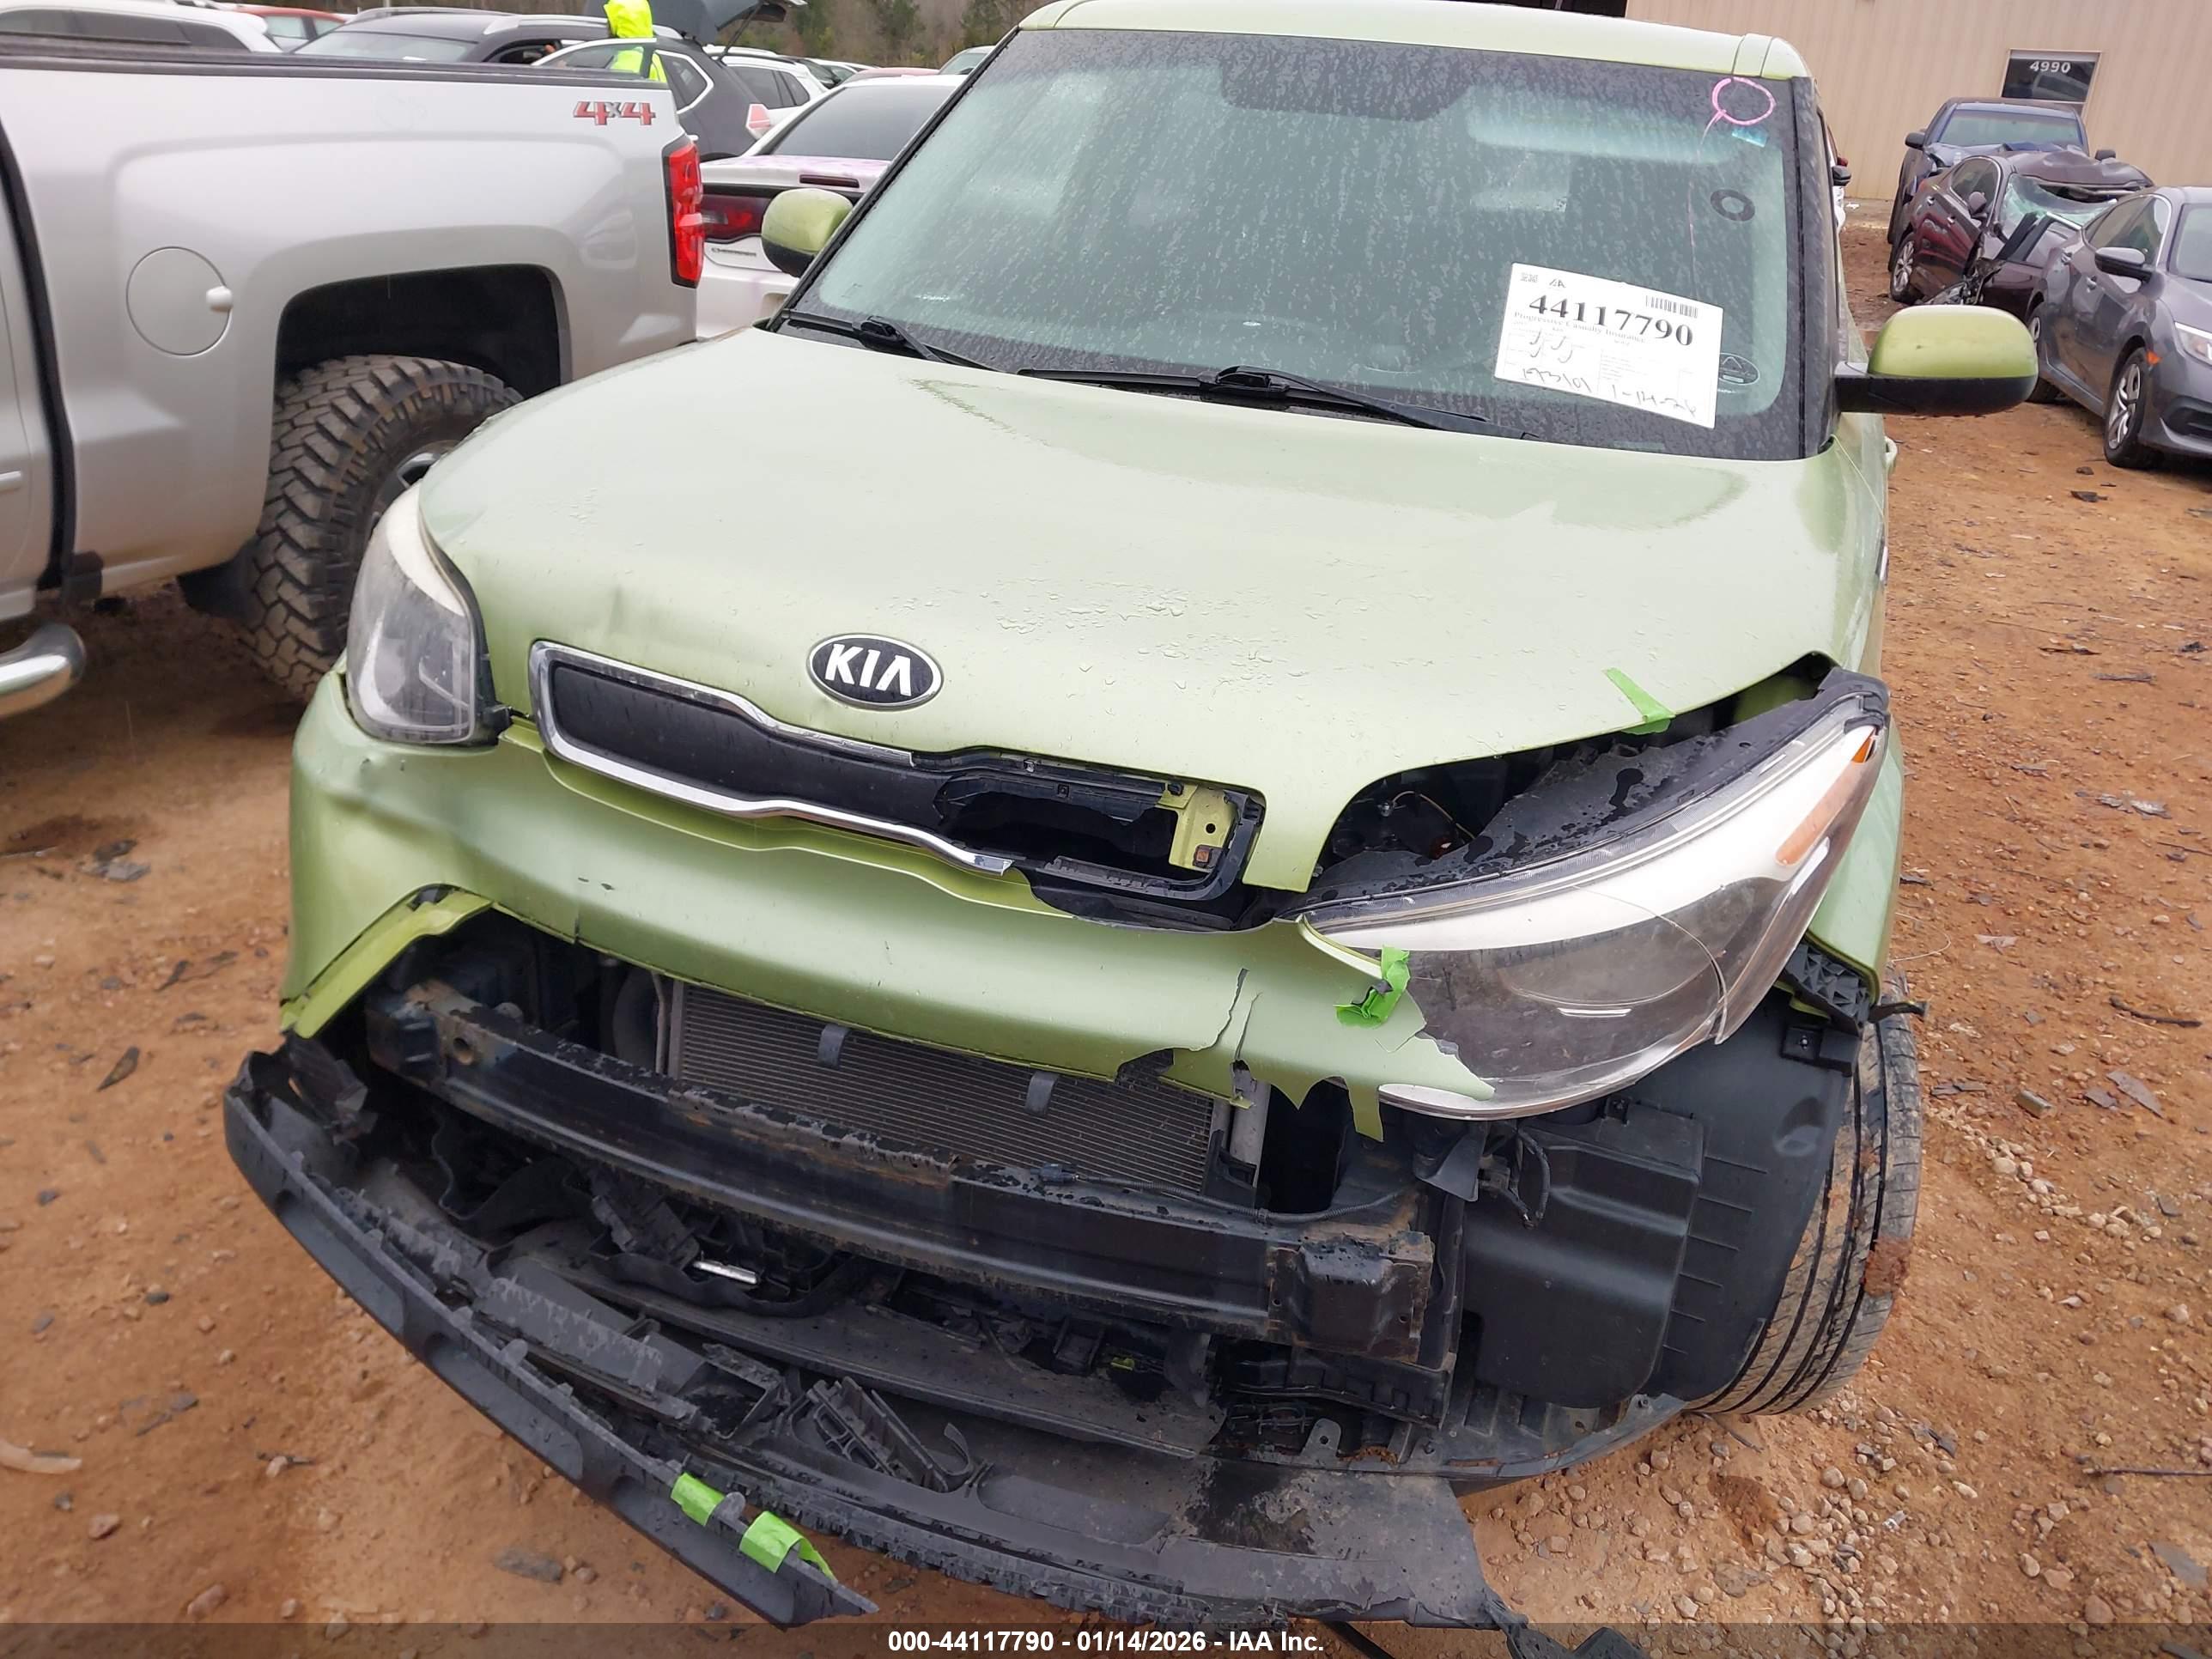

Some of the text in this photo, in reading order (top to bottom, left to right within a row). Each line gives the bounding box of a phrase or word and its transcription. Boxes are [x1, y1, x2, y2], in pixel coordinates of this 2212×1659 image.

[2030, 61, 2071, 73] 4990
[1529, 295, 1693, 346] 44117790
[824, 643, 912, 696] KIA
